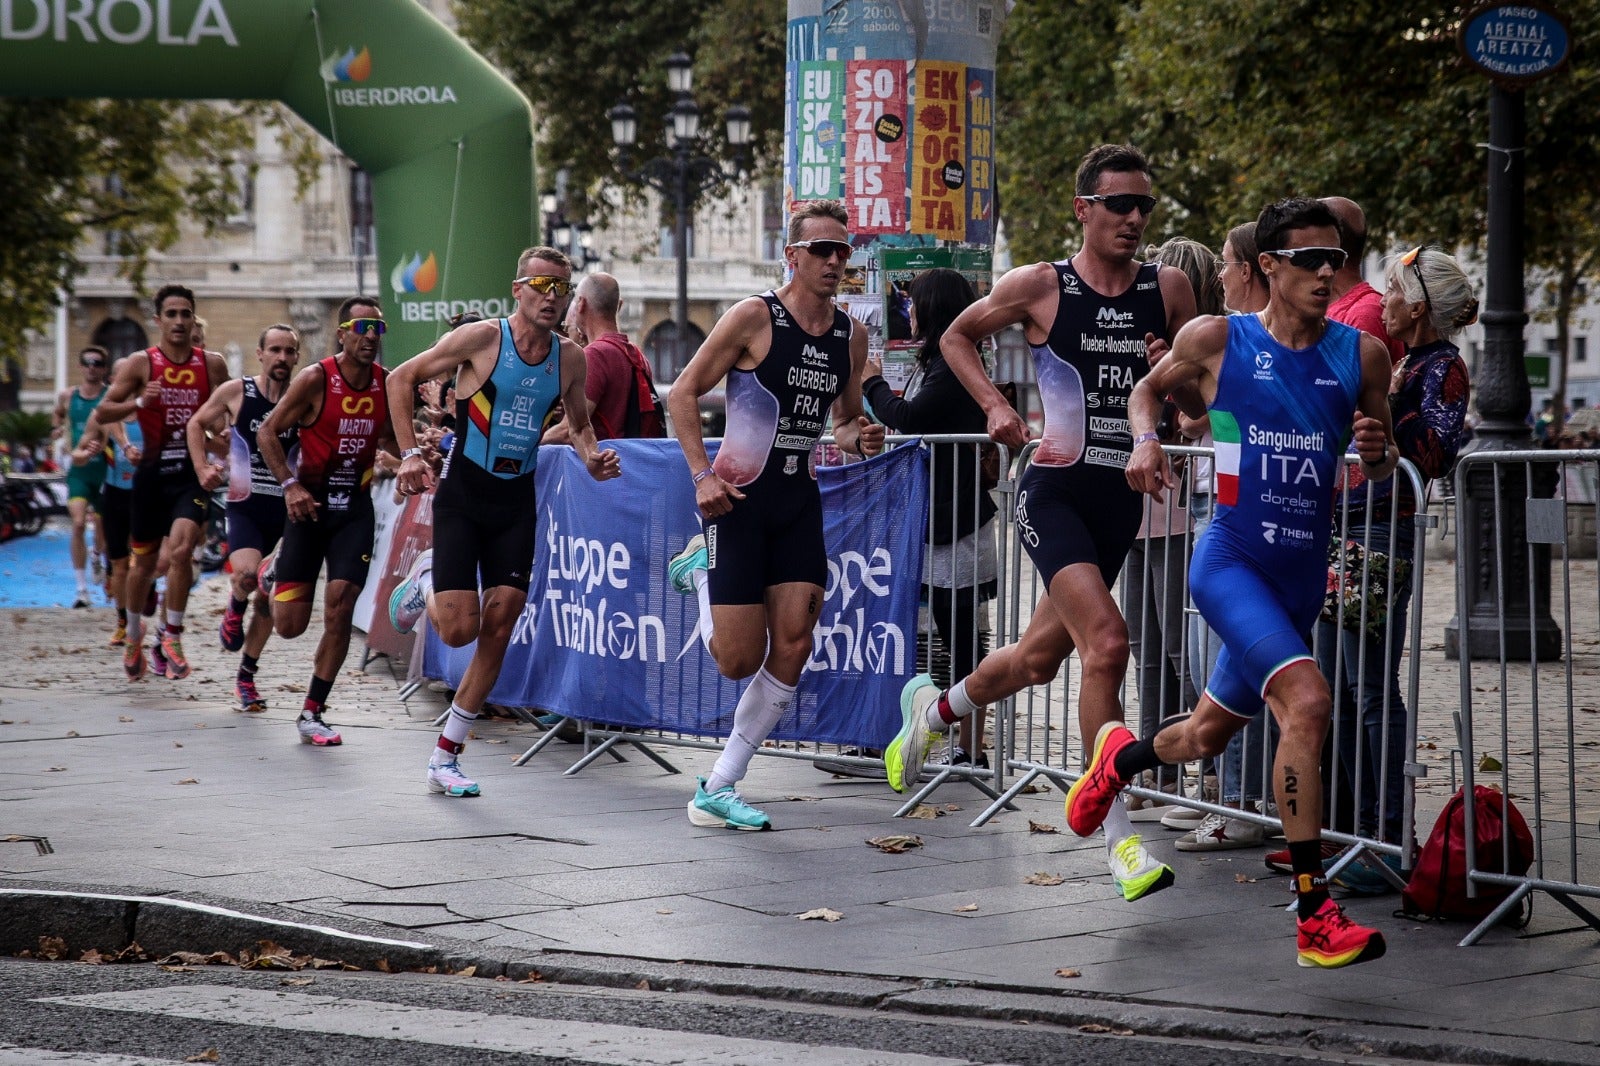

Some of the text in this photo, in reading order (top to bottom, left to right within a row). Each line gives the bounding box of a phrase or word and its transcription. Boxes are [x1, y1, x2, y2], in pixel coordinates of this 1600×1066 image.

[1498, 7, 1538, 20] PASEO
[862, 21, 901, 32] sábado
[1484, 22, 1548, 40] ARENAL
[1476, 40, 1553, 58] AREATZA
[1478, 54, 1550, 75] PASEALEKUA
[334, 85, 458, 107] IBERDROLA
[401, 298, 519, 323] IBERDROL
[1095, 306, 1134, 321] Metz
[801, 343, 829, 361] Metz
[1080, 332, 1147, 358] Hueber-Moosbrugg
[787, 366, 838, 394] GUERBEUR
[1098, 365, 1135, 390] FRA
[511, 394, 536, 413] DELY
[793, 394, 821, 417] FRA
[1107, 395, 1130, 406] SFE
[166, 408, 192, 425] ESP
[498, 410, 538, 432] BEL
[1091, 418, 1133, 433] Moselle
[338, 438, 366, 454] ESP
[1248, 424, 1324, 453] Sanguinetti
[1261, 453, 1321, 488] ITA
[1260, 488, 1318, 509] dorelan
[1281, 527, 1314, 540] THEMA
